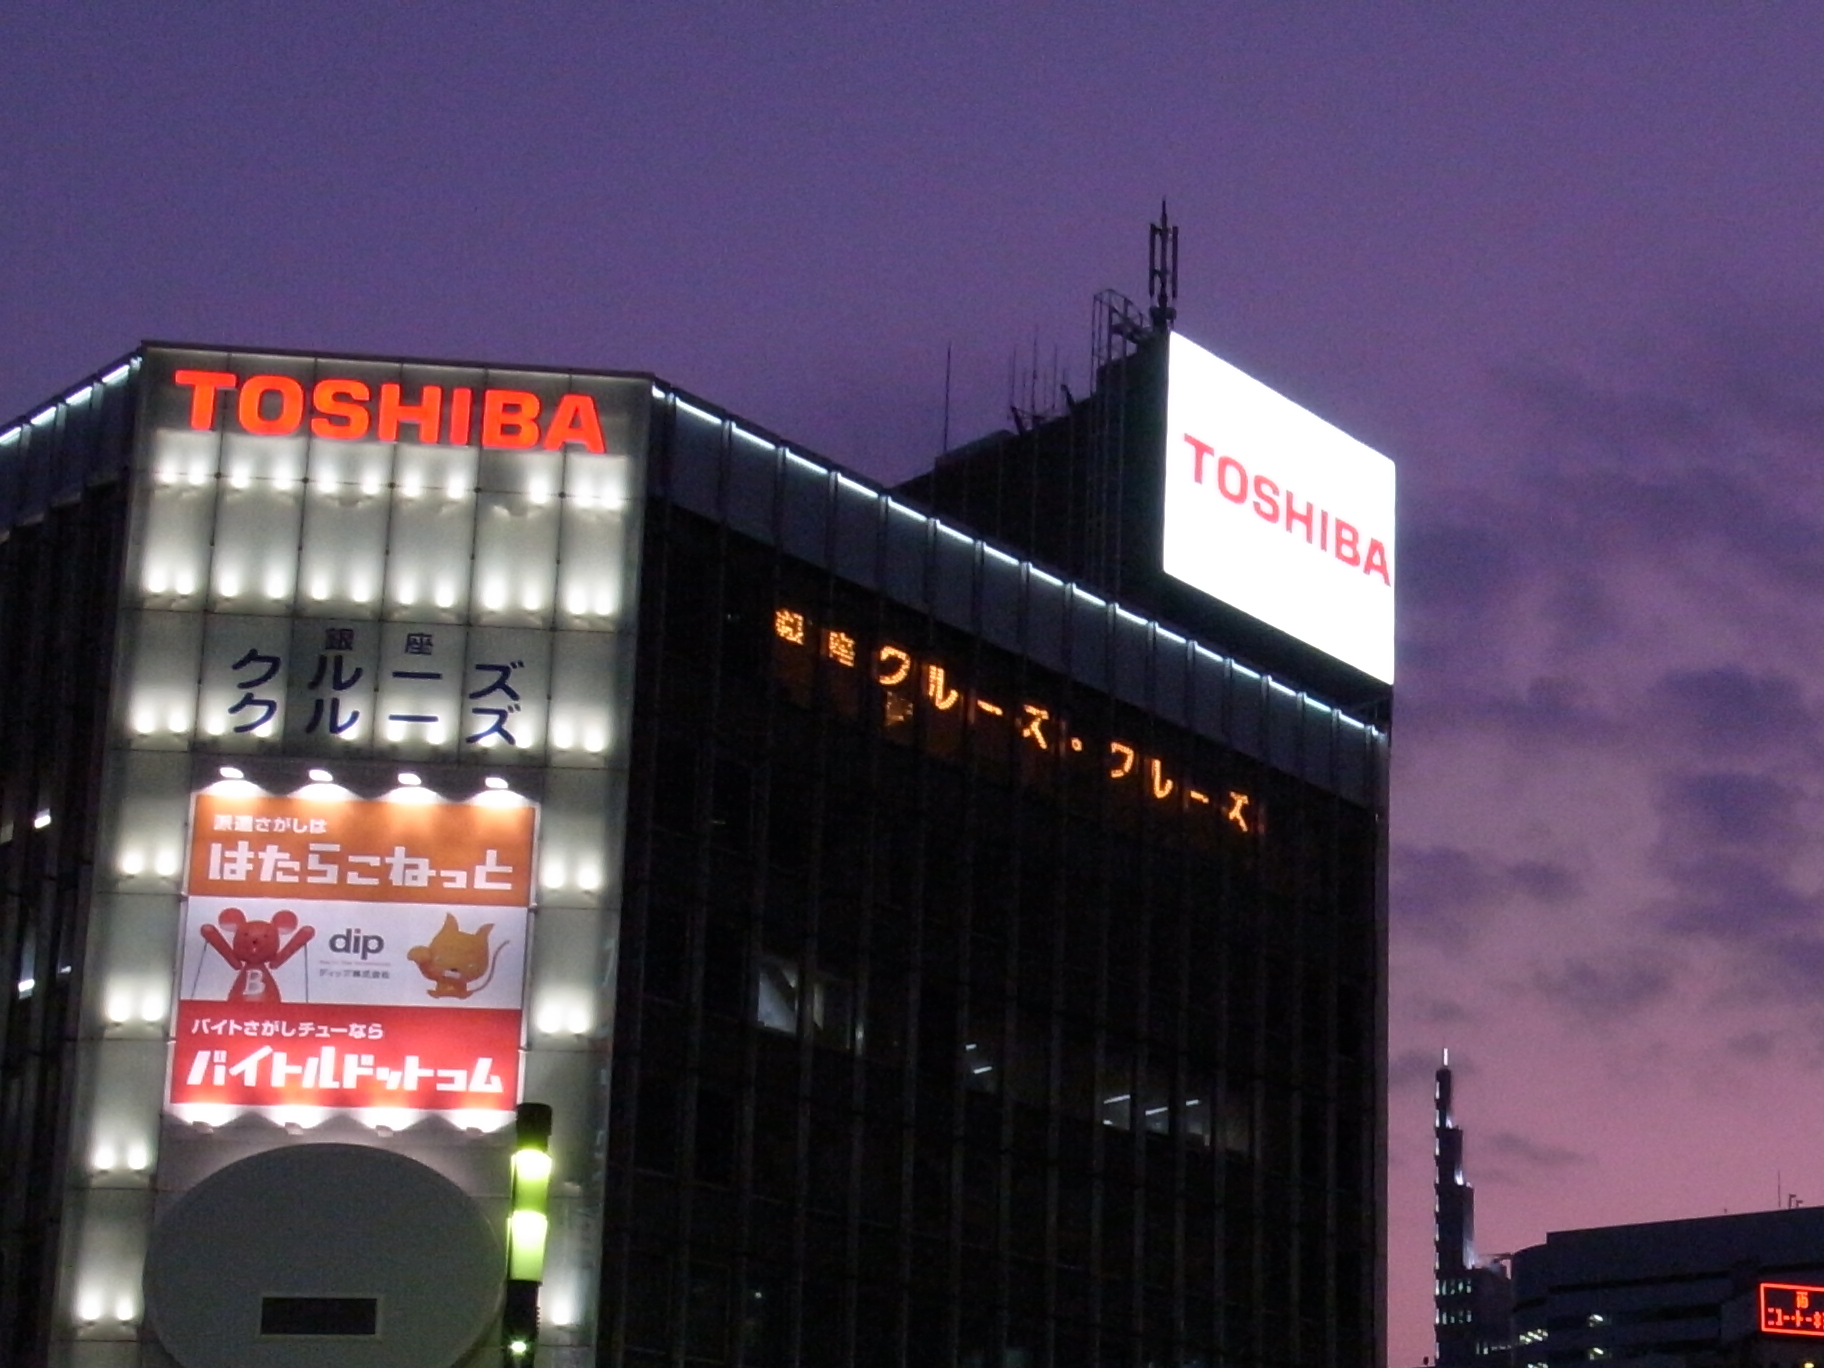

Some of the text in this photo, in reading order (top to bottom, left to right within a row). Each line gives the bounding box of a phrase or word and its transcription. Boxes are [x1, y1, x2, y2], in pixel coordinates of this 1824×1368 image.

[175, 369, 607, 453] TOSHIBA
[1183, 433, 1392, 587] TOSHIBA
[324, 627, 434, 656] 銀座
[231, 650, 525, 702] クルーズ
[228, 694, 521, 746] クルーズ
[208, 840, 514, 891] はたらこねっと
[329, 928, 384, 960] dip
[243, 970, 266, 996] B
[191, 1018, 385, 1041] バイトさがしチューなら
[186, 1044, 504, 1094] バイトルドットコム
